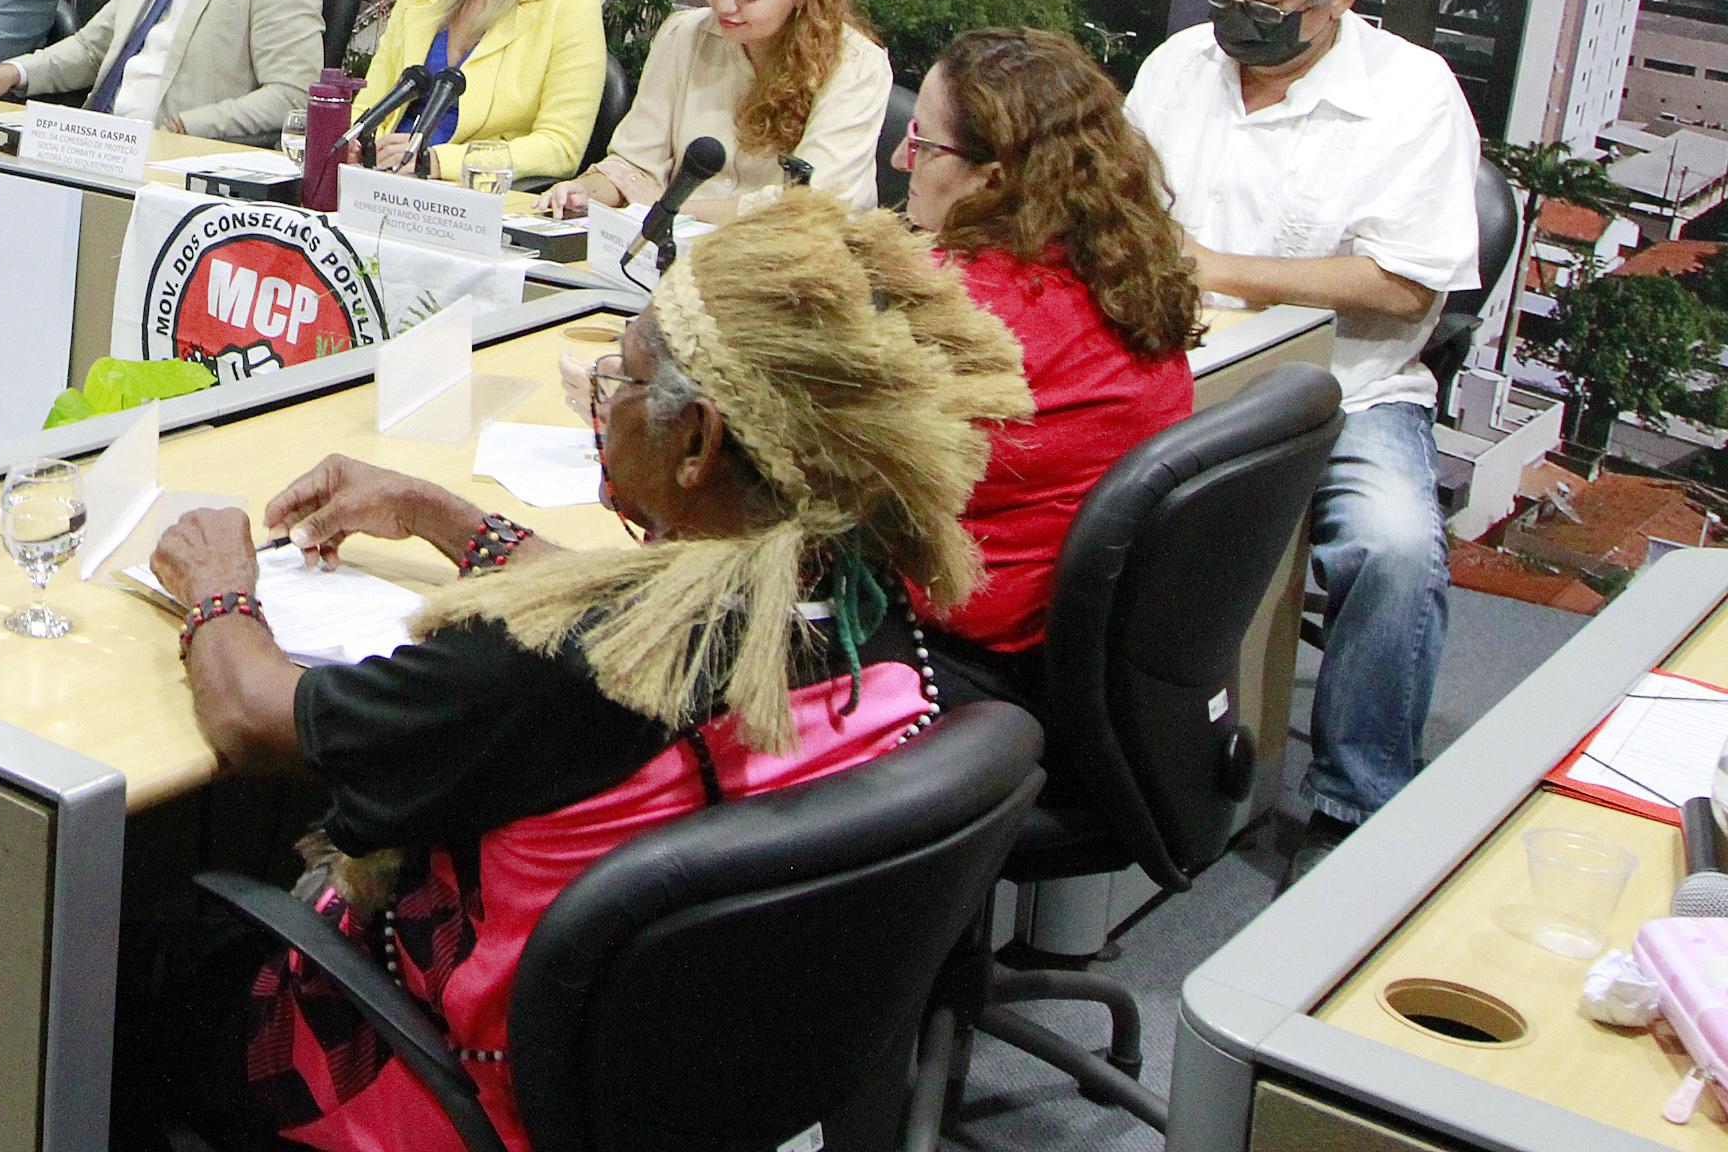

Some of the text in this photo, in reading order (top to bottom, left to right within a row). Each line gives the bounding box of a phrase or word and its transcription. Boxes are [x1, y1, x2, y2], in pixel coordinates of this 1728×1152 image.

[31, 129, 138, 156] PRES. DA COMISSÃO DE PROTEÇÃO
[59, 122, 97, 137] LARISSA
[100, 130, 137, 144] GASPAR
[37, 141, 59, 152] SOCIAL
[61, 144, 65, 152] E
[66, 146, 95, 158] COMBATE
[103, 154, 121, 164] FOME
[37, 151, 123, 174] AUTORA DO REQUERIMENTO
[353, 200, 487, 235] REPRESENTANDO SECRETARIA DE
[373, 190, 467, 219] PAULA QUEIROZ
[425, 226, 456, 240] SOCIAL
[155, 281, 179, 336] MOV.
[173, 233, 200, 276] DOS
[203, 212, 321, 253] CONSELHOS
[207, 258, 319, 345] MCP
